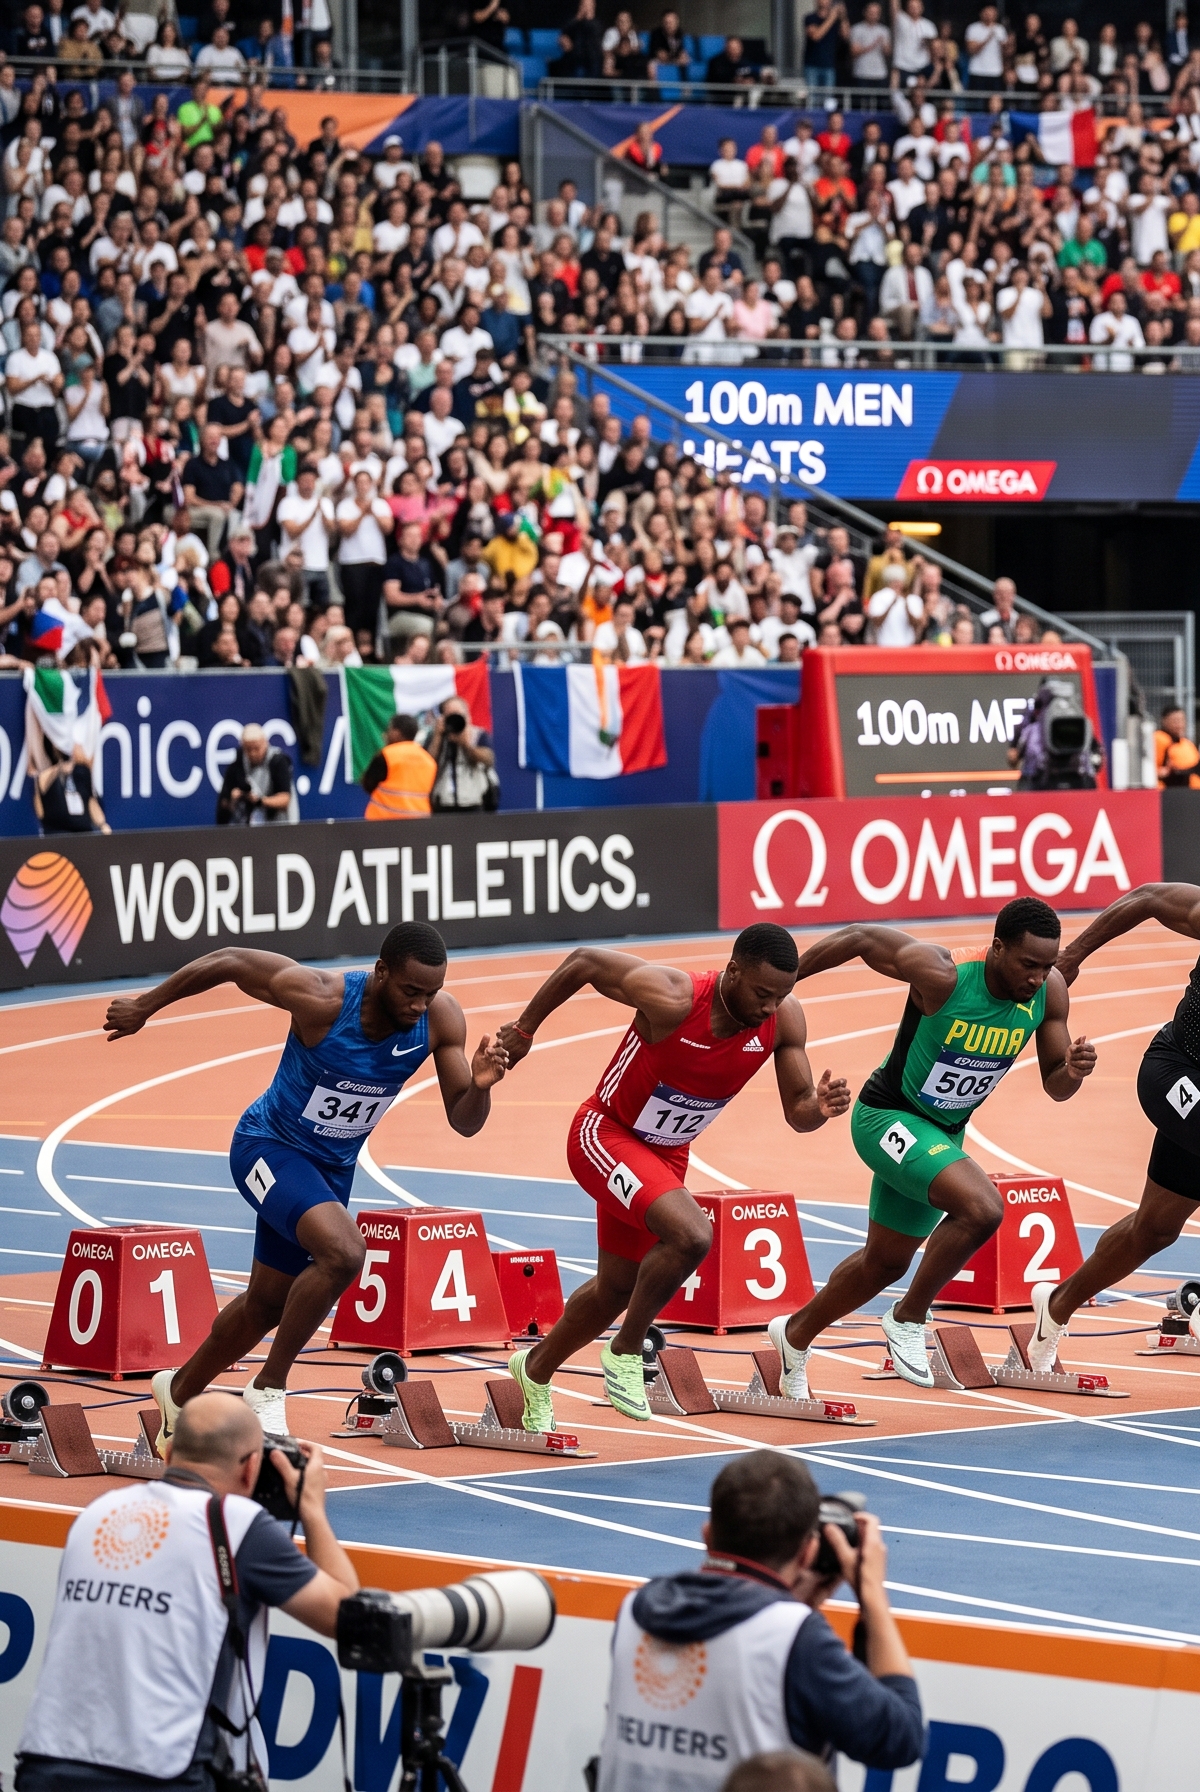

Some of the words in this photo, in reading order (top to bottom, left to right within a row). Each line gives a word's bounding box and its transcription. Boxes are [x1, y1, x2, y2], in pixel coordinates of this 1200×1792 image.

[685, 380, 803, 426] 100m
[813, 382, 913, 427] MEN
[946, 467, 1038, 495] OMEGA
[1014, 652, 1077, 671] OMEGA
[856, 700, 960, 746] 100m
[850, 808, 1131, 905] OMEGA
[109, 854, 316, 944] WORLD
[327, 834, 638, 929] ATHLETICS
[944, 1019, 1025, 1056] PUMA
[935, 1071, 994, 1097] 508
[1179, 1083, 1193, 1109] 4
[317, 1096, 381, 1124] 341
[655, 1109, 705, 1134] 112
[888, 1131, 906, 1155] 3
[254, 1168, 267, 1192] 1
[613, 1173, 634, 1199] 2
[1006, 1187, 1061, 1205] OMEGA
[731, 1202, 790, 1221] OMEGA
[360, 1222, 401, 1241] OMEGA
[417, 1222, 479, 1241] OMEGA
[71, 1241, 114, 1262] OMEGA
[132, 1241, 196, 1261] OMEGA
[1018, 1211, 1061, 1283] 2
[743, 1227, 787, 1301] 3
[354, 1249, 390, 1323] 5
[430, 1249, 477, 1322] 4
[68, 1268, 103, 1345] 0
[149, 1269, 181, 1345] 1
[63, 1579, 173, 1615] REUTERS
